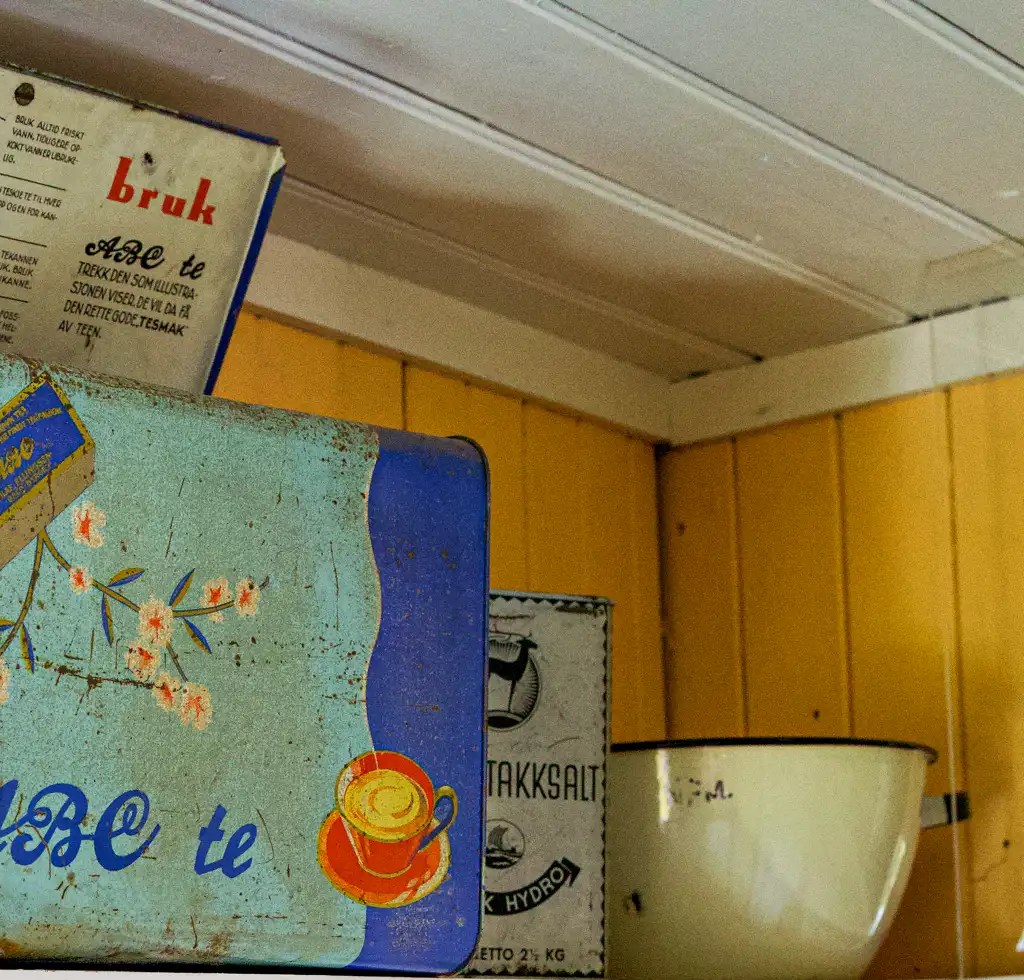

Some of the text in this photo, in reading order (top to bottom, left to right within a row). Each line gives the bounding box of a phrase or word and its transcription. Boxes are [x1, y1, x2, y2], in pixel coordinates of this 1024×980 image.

[15, 115, 85, 140] BRUK ALLTID FRISKT
[106, 155, 217, 225] bruk
[77, 260, 111, 281] TREKK
[110, 269, 132, 285] DEN
[131, 272, 154, 289] SOM
[85, 236, 206, 280] ABC te
[63, 299, 184, 337] DEN RETTE TESMAK
[70, 281, 191, 320] SJONEN DE VIL DA FÅ
[59, 319, 73, 334] AV
[194, 804, 258, 879] te
[506, 867, 565, 912] HYDRO
[546, 948, 565, 961] KG
